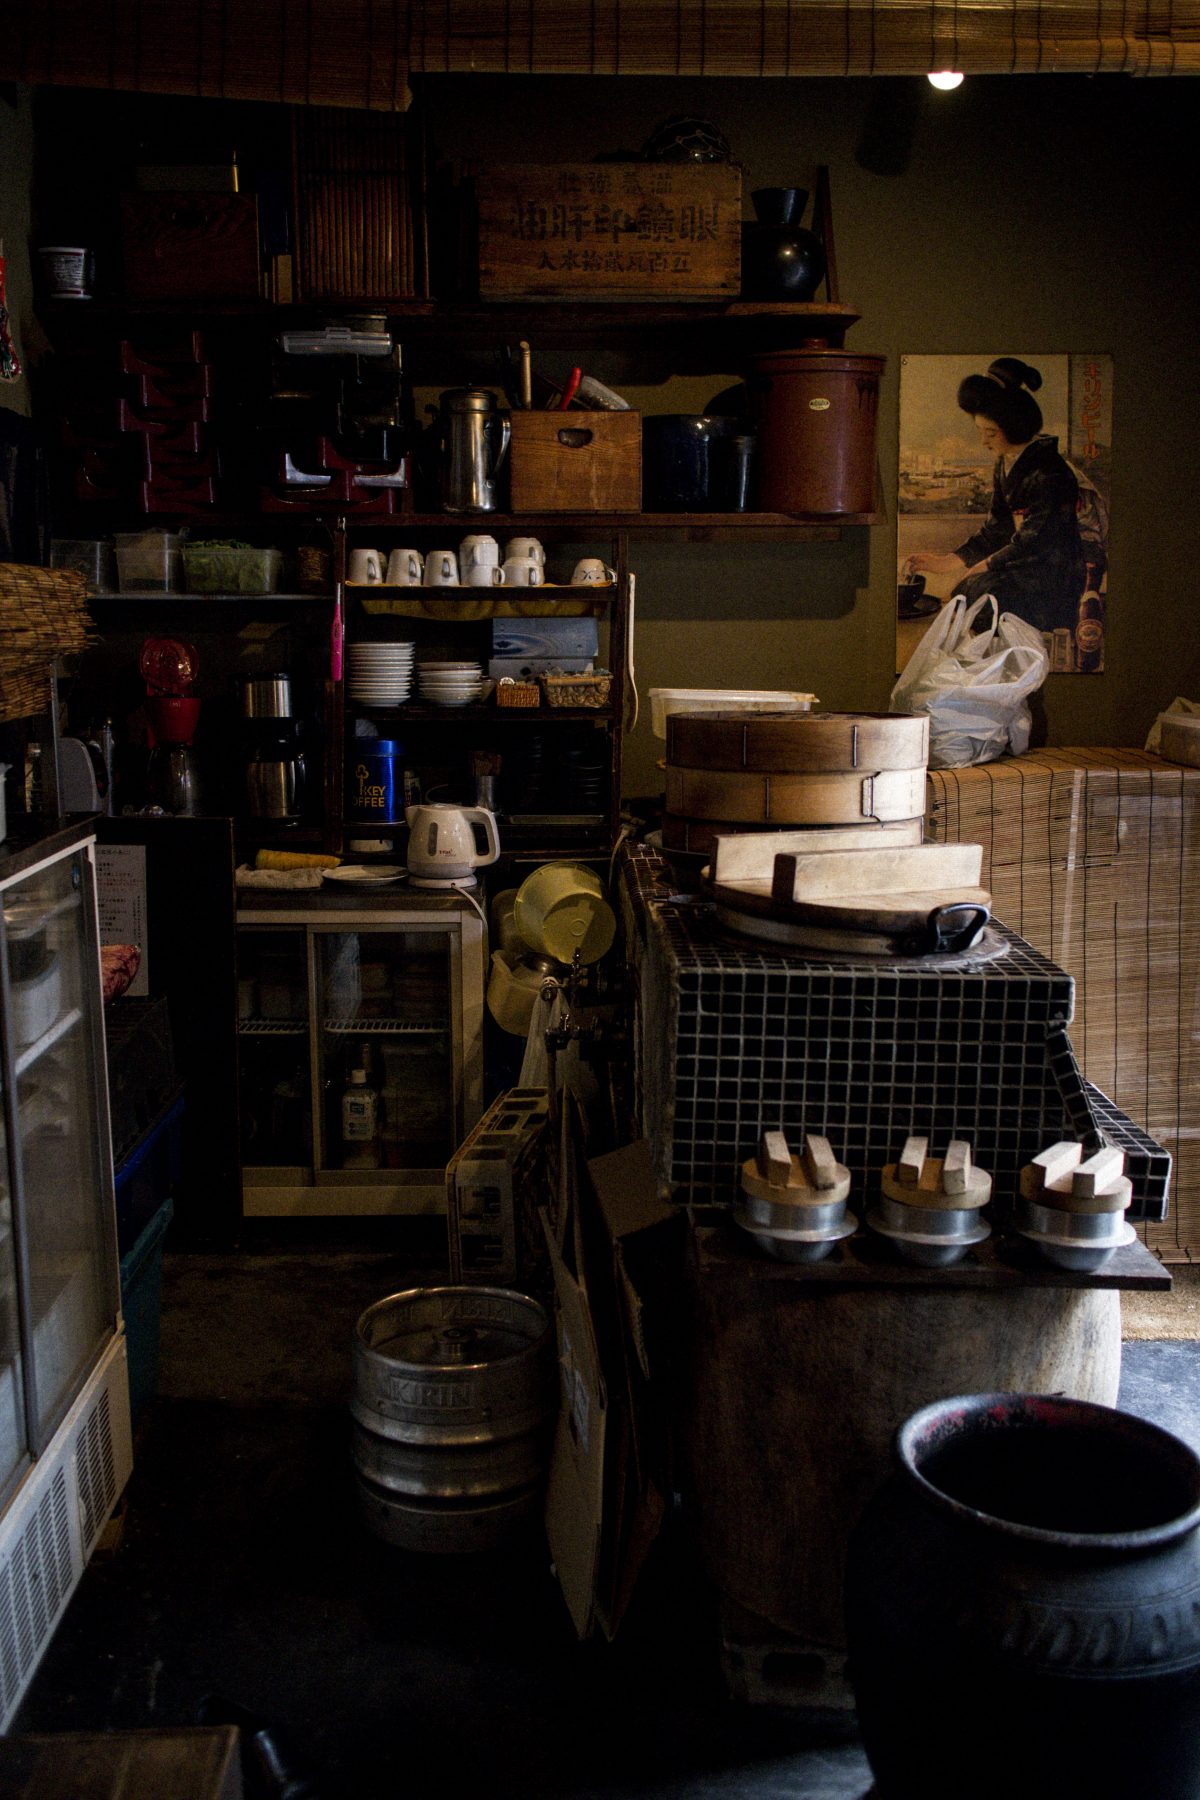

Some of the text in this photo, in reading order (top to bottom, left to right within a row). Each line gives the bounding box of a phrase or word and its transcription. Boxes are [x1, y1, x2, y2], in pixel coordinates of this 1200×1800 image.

[1082, 363, 1101, 459] キリンビール
[362, 785, 387, 796] KEY
[351, 796, 385, 808] OFFEE
[393, 1378, 473, 1407] KIRIN
